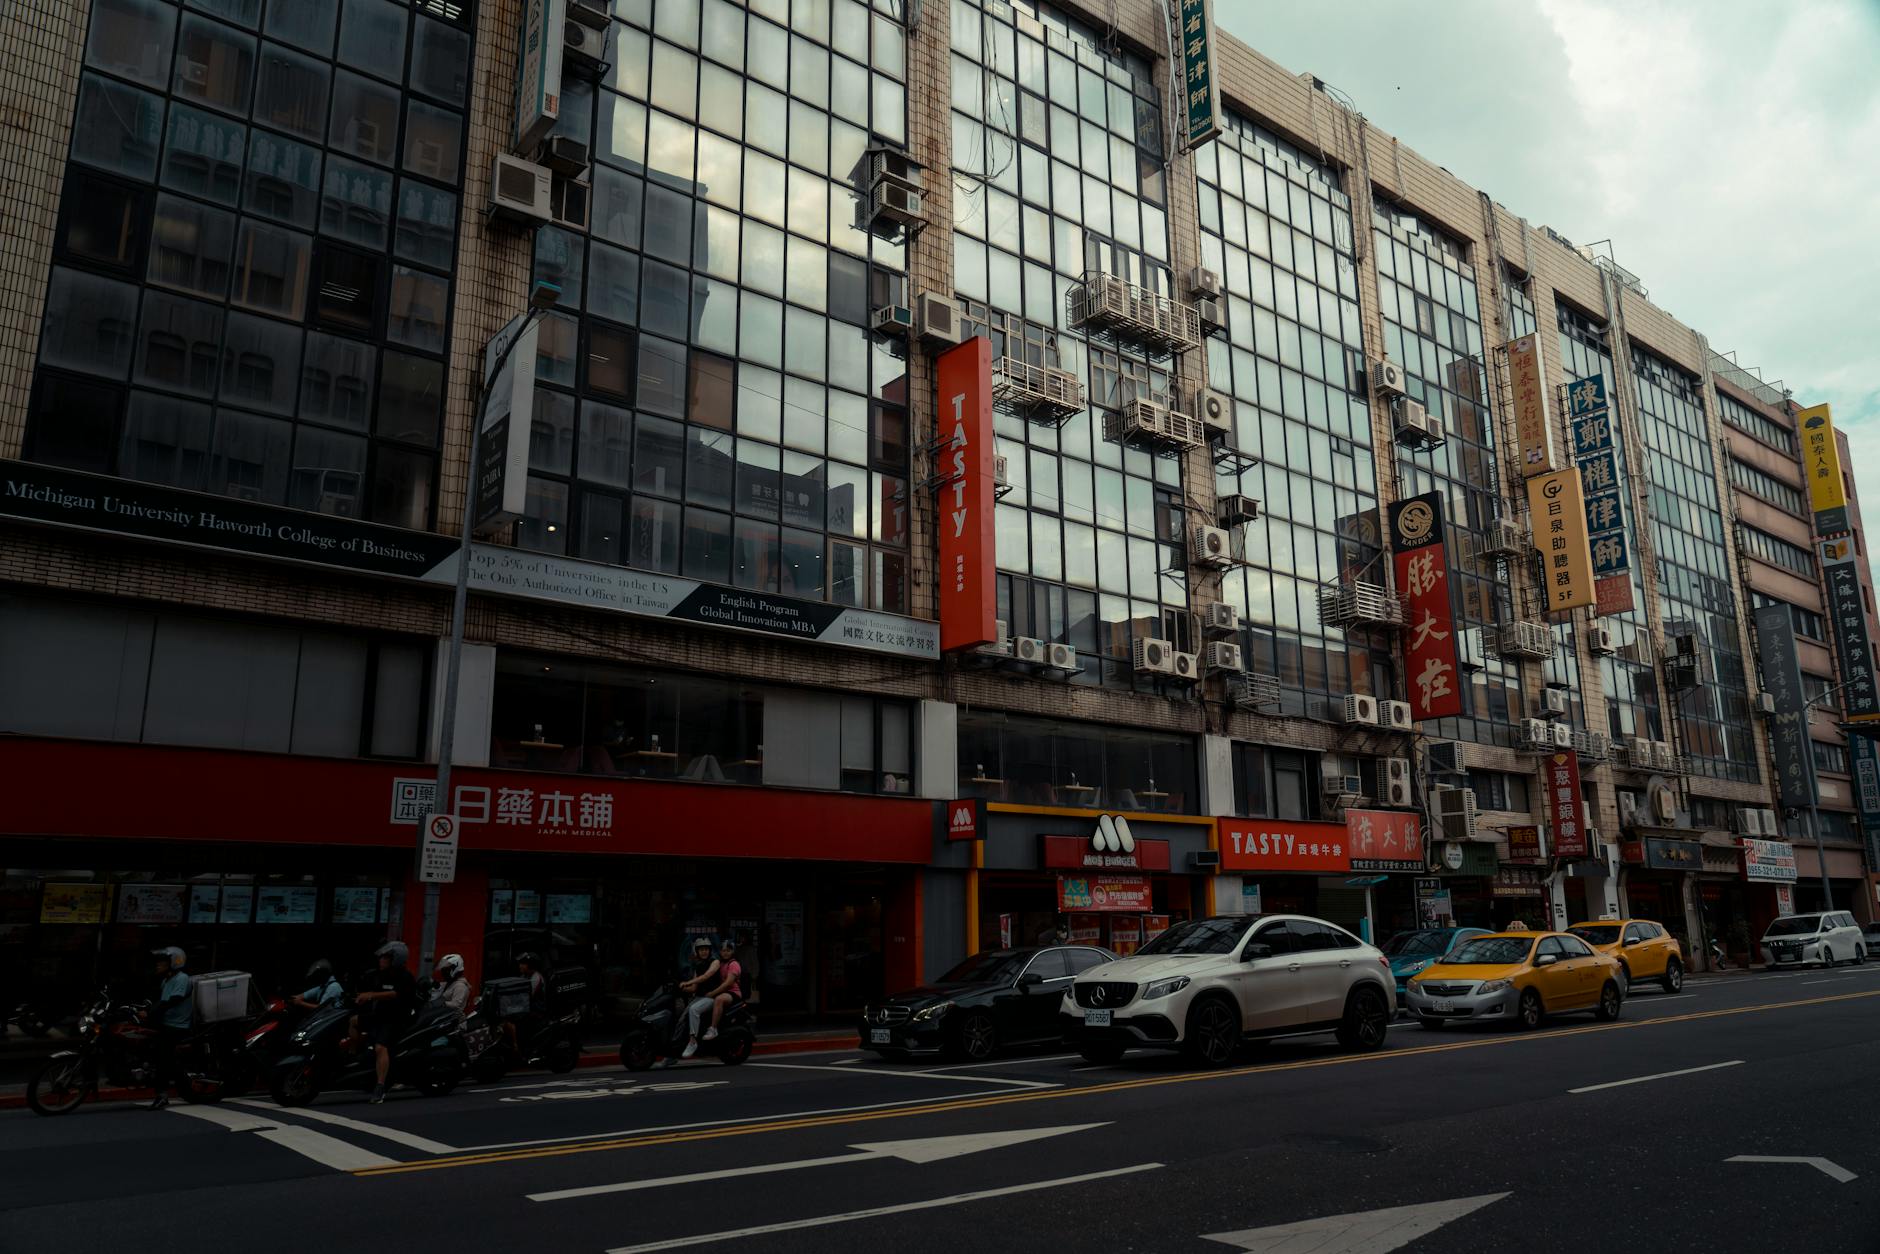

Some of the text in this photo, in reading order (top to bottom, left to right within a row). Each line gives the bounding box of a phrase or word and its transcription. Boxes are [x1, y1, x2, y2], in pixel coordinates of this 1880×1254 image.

[951, 393, 968, 538] TASTY
[4, 479, 426, 563] Michigan University Haworth College of Business
[1547, 502, 1570, 586] 巨泉助聽器
[501, 555, 523, 570] 5%
[527, 560, 540, 572] of
[545, 564, 612, 587] Universities
[652, 581, 669, 594] US
[490, 570, 518, 589] Only
[523, 577, 582, 597] Authorized
[585, 586, 617, 602] Office
[622, 592, 632, 604] in
[635, 593, 669, 610] Taiwan
[1558, 590, 1573, 602] 5F
[719, 593, 799, 618] English Program
[699, 605, 816, 634] Global Innovation MBA
[844, 615, 934, 638] Global International Camp
[843, 625, 935, 651] 國際文化交流學習營
[453, 785, 614, 829] 日藥本舖
[572, 829, 613, 837] MEDICAL
[1231, 831, 1295, 856] TASTY
[1083, 855, 1138, 868] MOS BURGER
